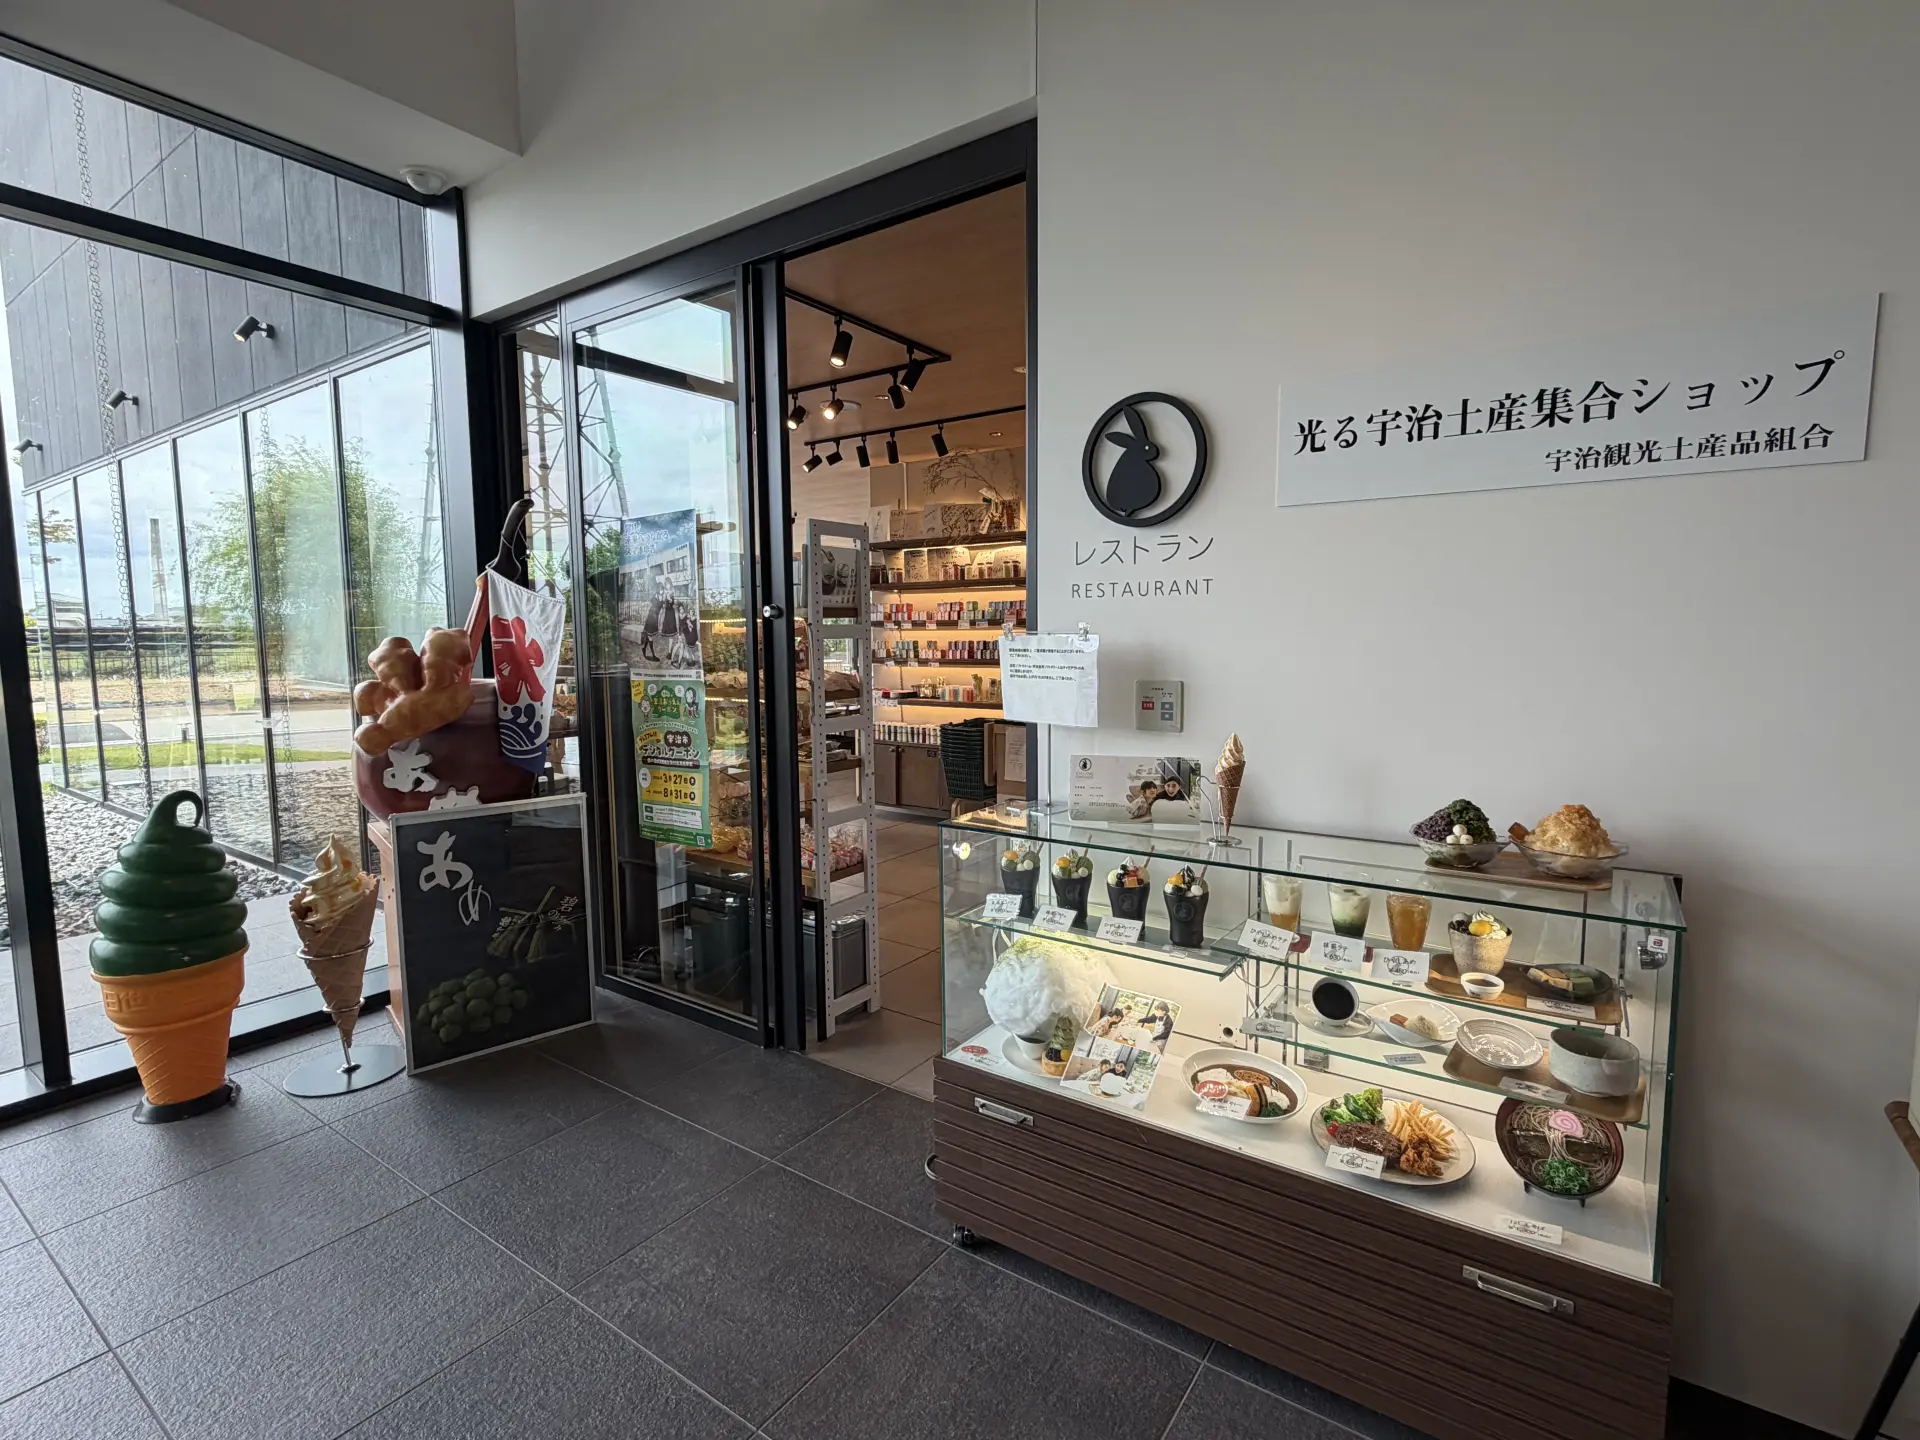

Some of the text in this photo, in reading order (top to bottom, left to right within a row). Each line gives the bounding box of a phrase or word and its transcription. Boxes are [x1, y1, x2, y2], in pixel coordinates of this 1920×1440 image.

[1294, 350, 1845, 455] 光る宇治土産集合ショップ
[1545, 423, 1834, 472] 宇治観光土産品組合
[1075, 534, 1214, 566] レストラン
[1071, 578, 1214, 599] RESTAURANT
[642, 744, 700, 759] デジタルクーポン
[666, 734, 689, 744] 宇治市
[417, 831, 492, 926] あめ
